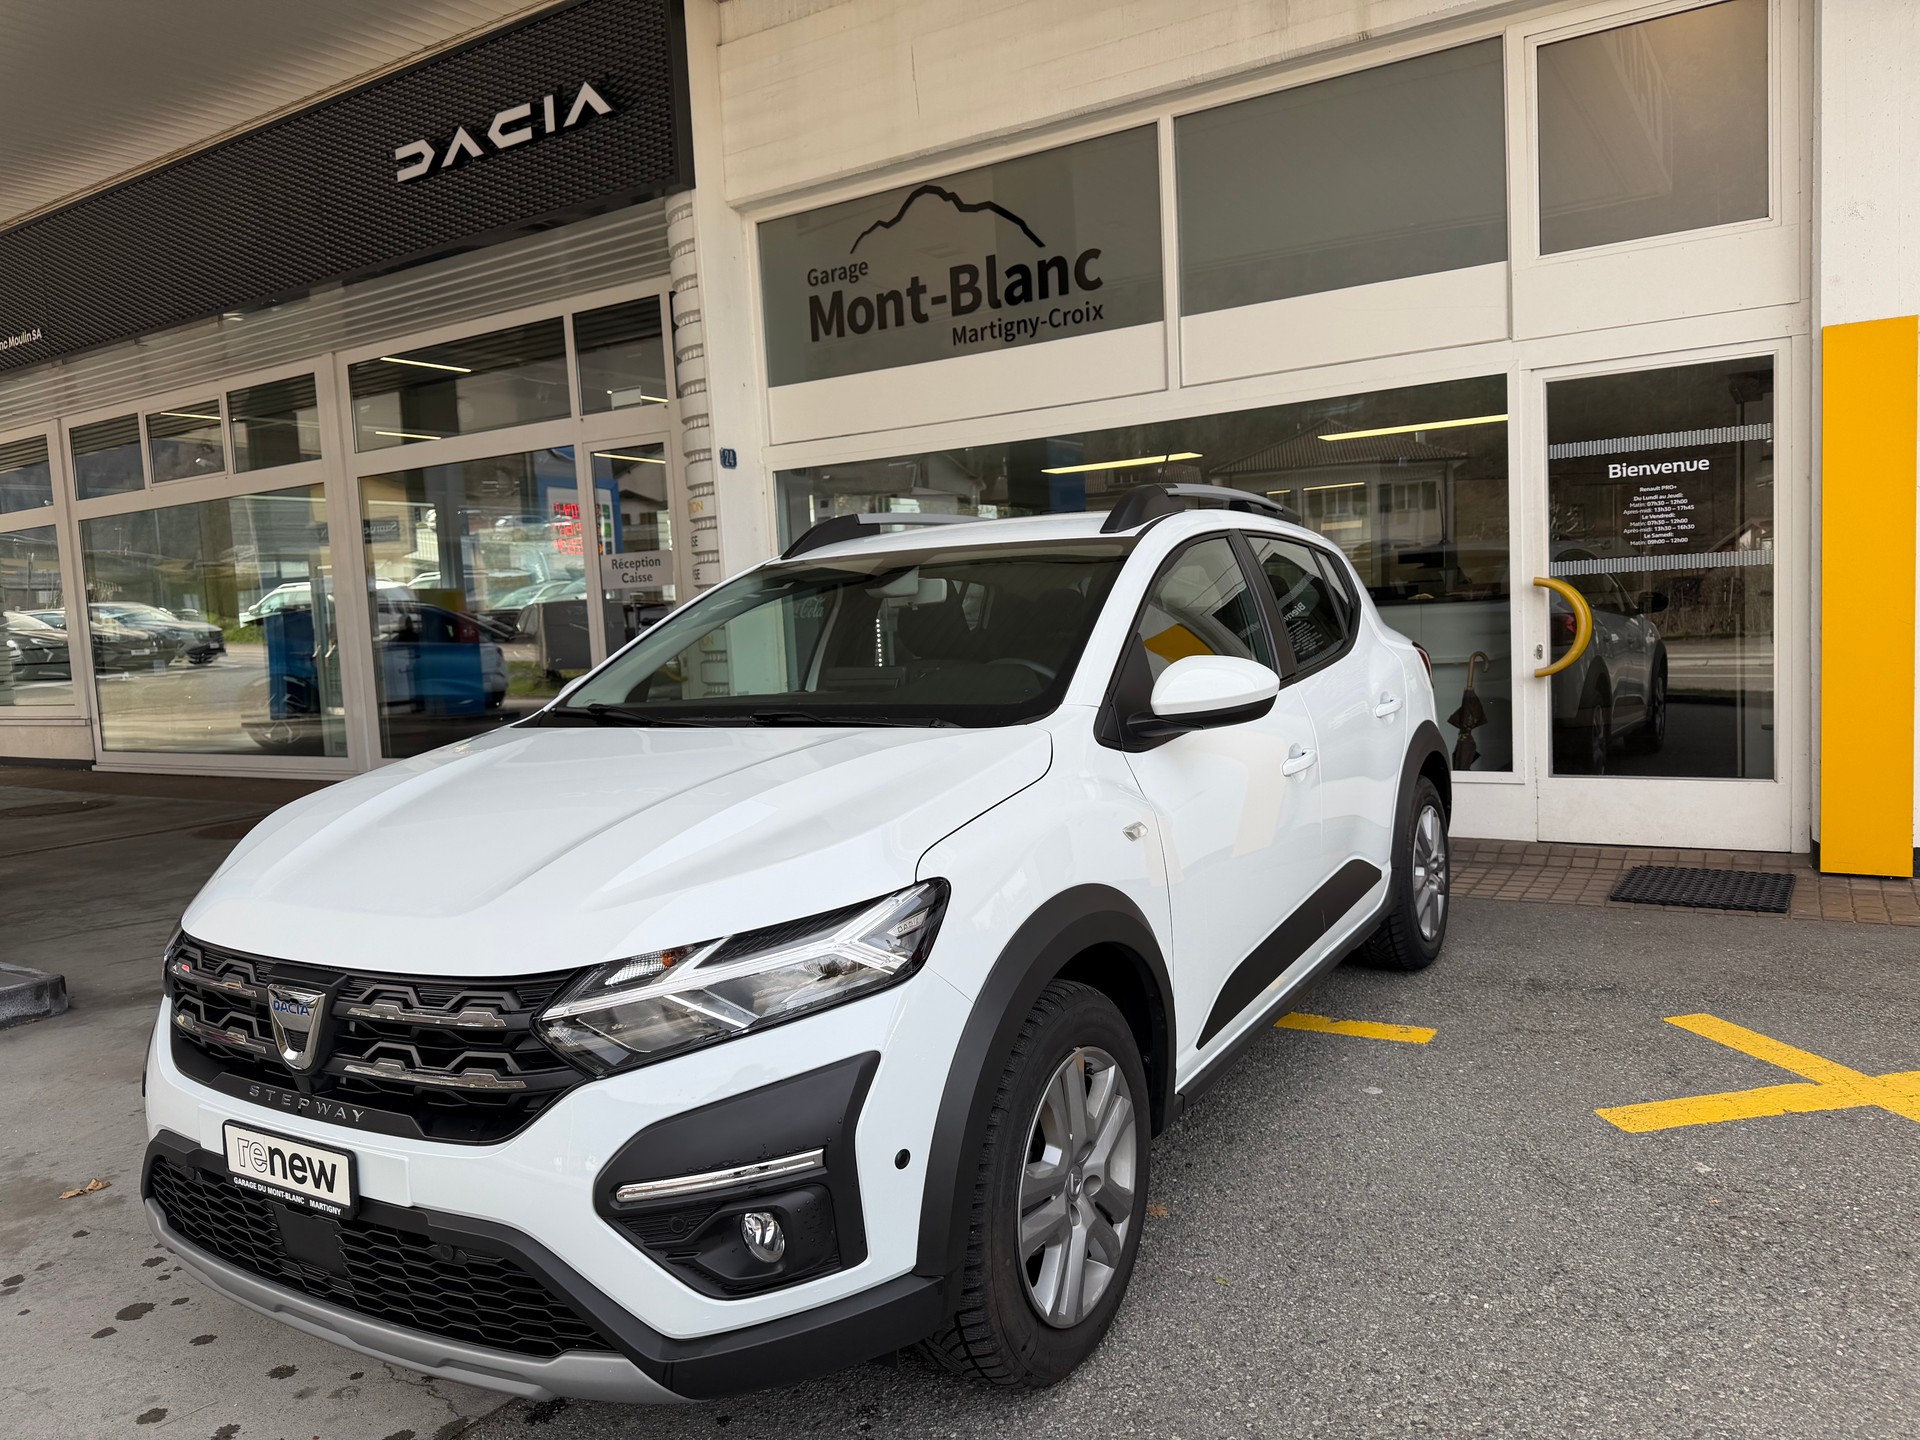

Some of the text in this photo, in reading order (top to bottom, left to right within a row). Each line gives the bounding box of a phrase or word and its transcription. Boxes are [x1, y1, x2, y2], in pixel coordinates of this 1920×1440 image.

[395, 81, 613, 182] DACIA
[807, 261, 869, 287] Garage
[808, 248, 1104, 342] Mont-Blanc
[8, 331, 32, 348] Moulin
[32, 328, 42, 341] SA
[952, 301, 1104, 346] Martigny-Croix
[1608, 459, 1710, 479] Bienvenue
[611, 555, 661, 571] Réception
[621, 571, 653, 584] Caisse
[273, 1000, 310, 1016] DACIA
[249, 1085, 365, 1122] STEPWAY
[237, 1137, 337, 1194] renew
[233, 1176, 341, 1216] GARAGE DU MONT-BLANC MARTIGNY
